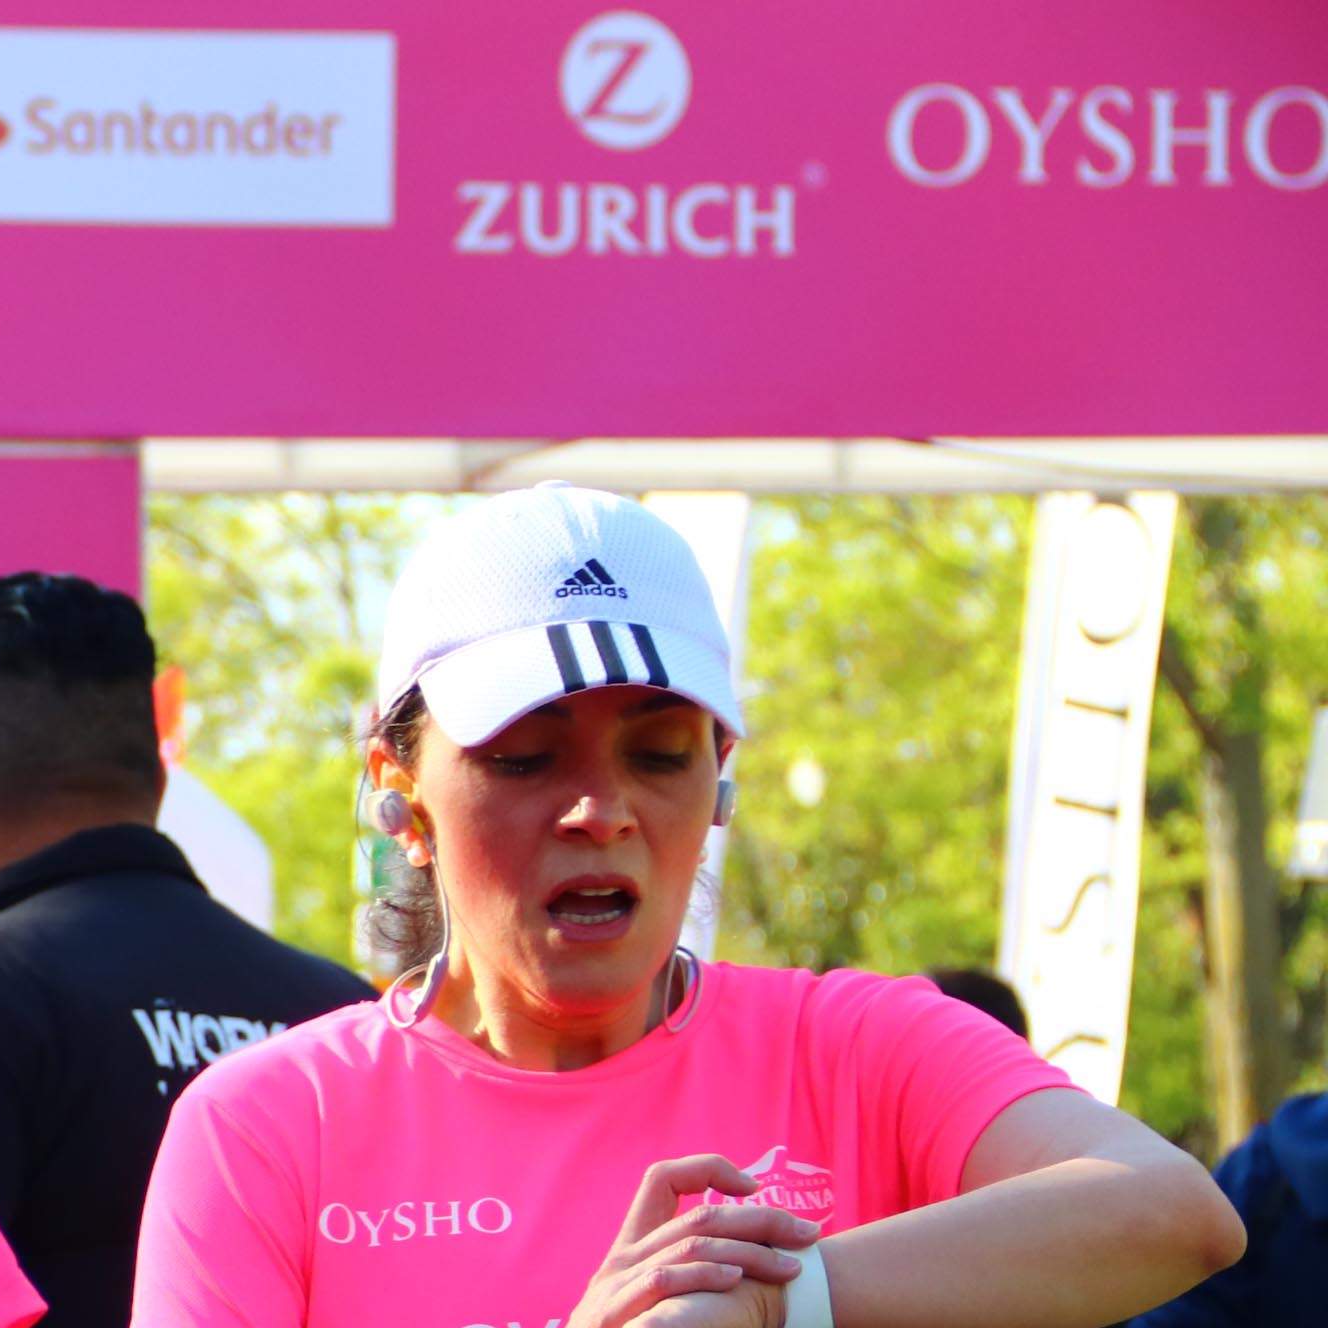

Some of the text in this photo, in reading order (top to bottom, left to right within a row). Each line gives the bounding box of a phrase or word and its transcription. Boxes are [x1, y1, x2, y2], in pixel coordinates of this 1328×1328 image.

[24, 98, 342, 157] Santander
[886, 83, 1328, 190] OYSHO
[454, 182, 796, 258] ZURICH
[555, 584, 628, 599] adidas
[318, 1197, 513, 1248] OYSHO
